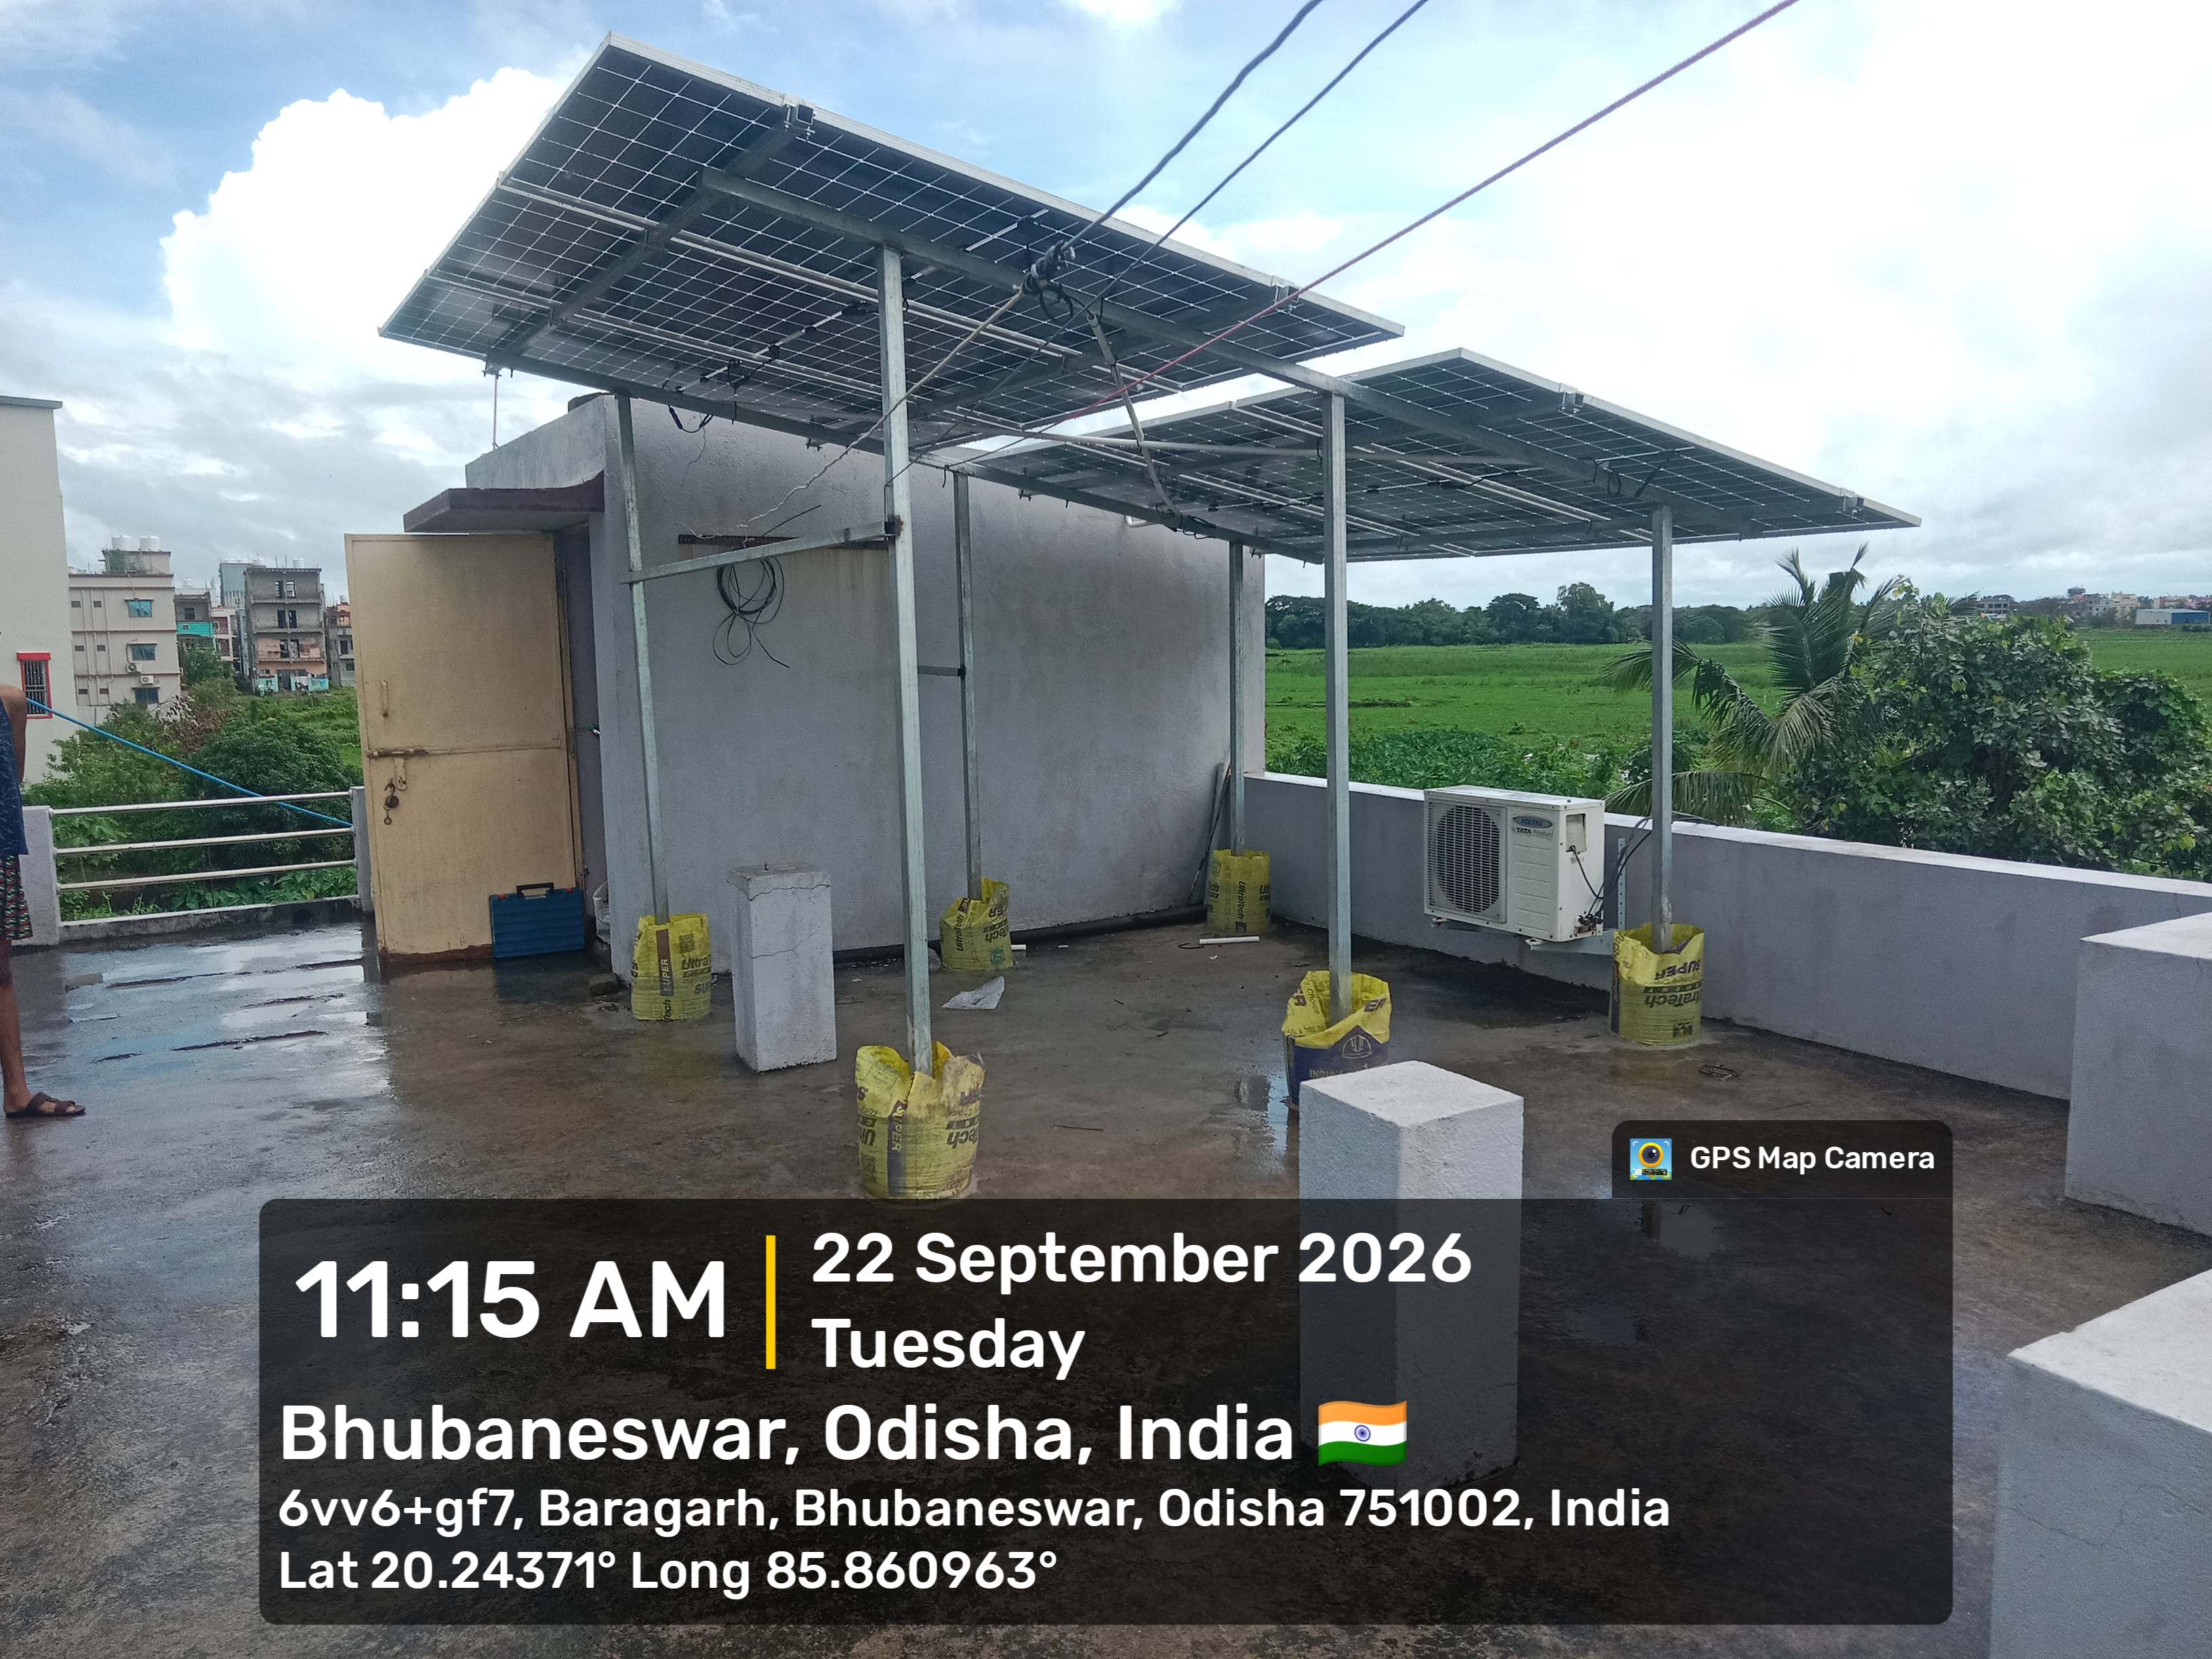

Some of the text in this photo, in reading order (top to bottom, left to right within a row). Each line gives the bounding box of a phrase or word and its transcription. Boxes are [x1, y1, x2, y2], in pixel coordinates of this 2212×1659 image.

[1516, 827, 1532, 835] TATA
[1521, 818, 1543, 826] VOLTAS
[1237, 880, 1247, 920] UltraTech
[954, 914, 964, 951] UltraTech
[660, 958, 672, 992] SUPER
